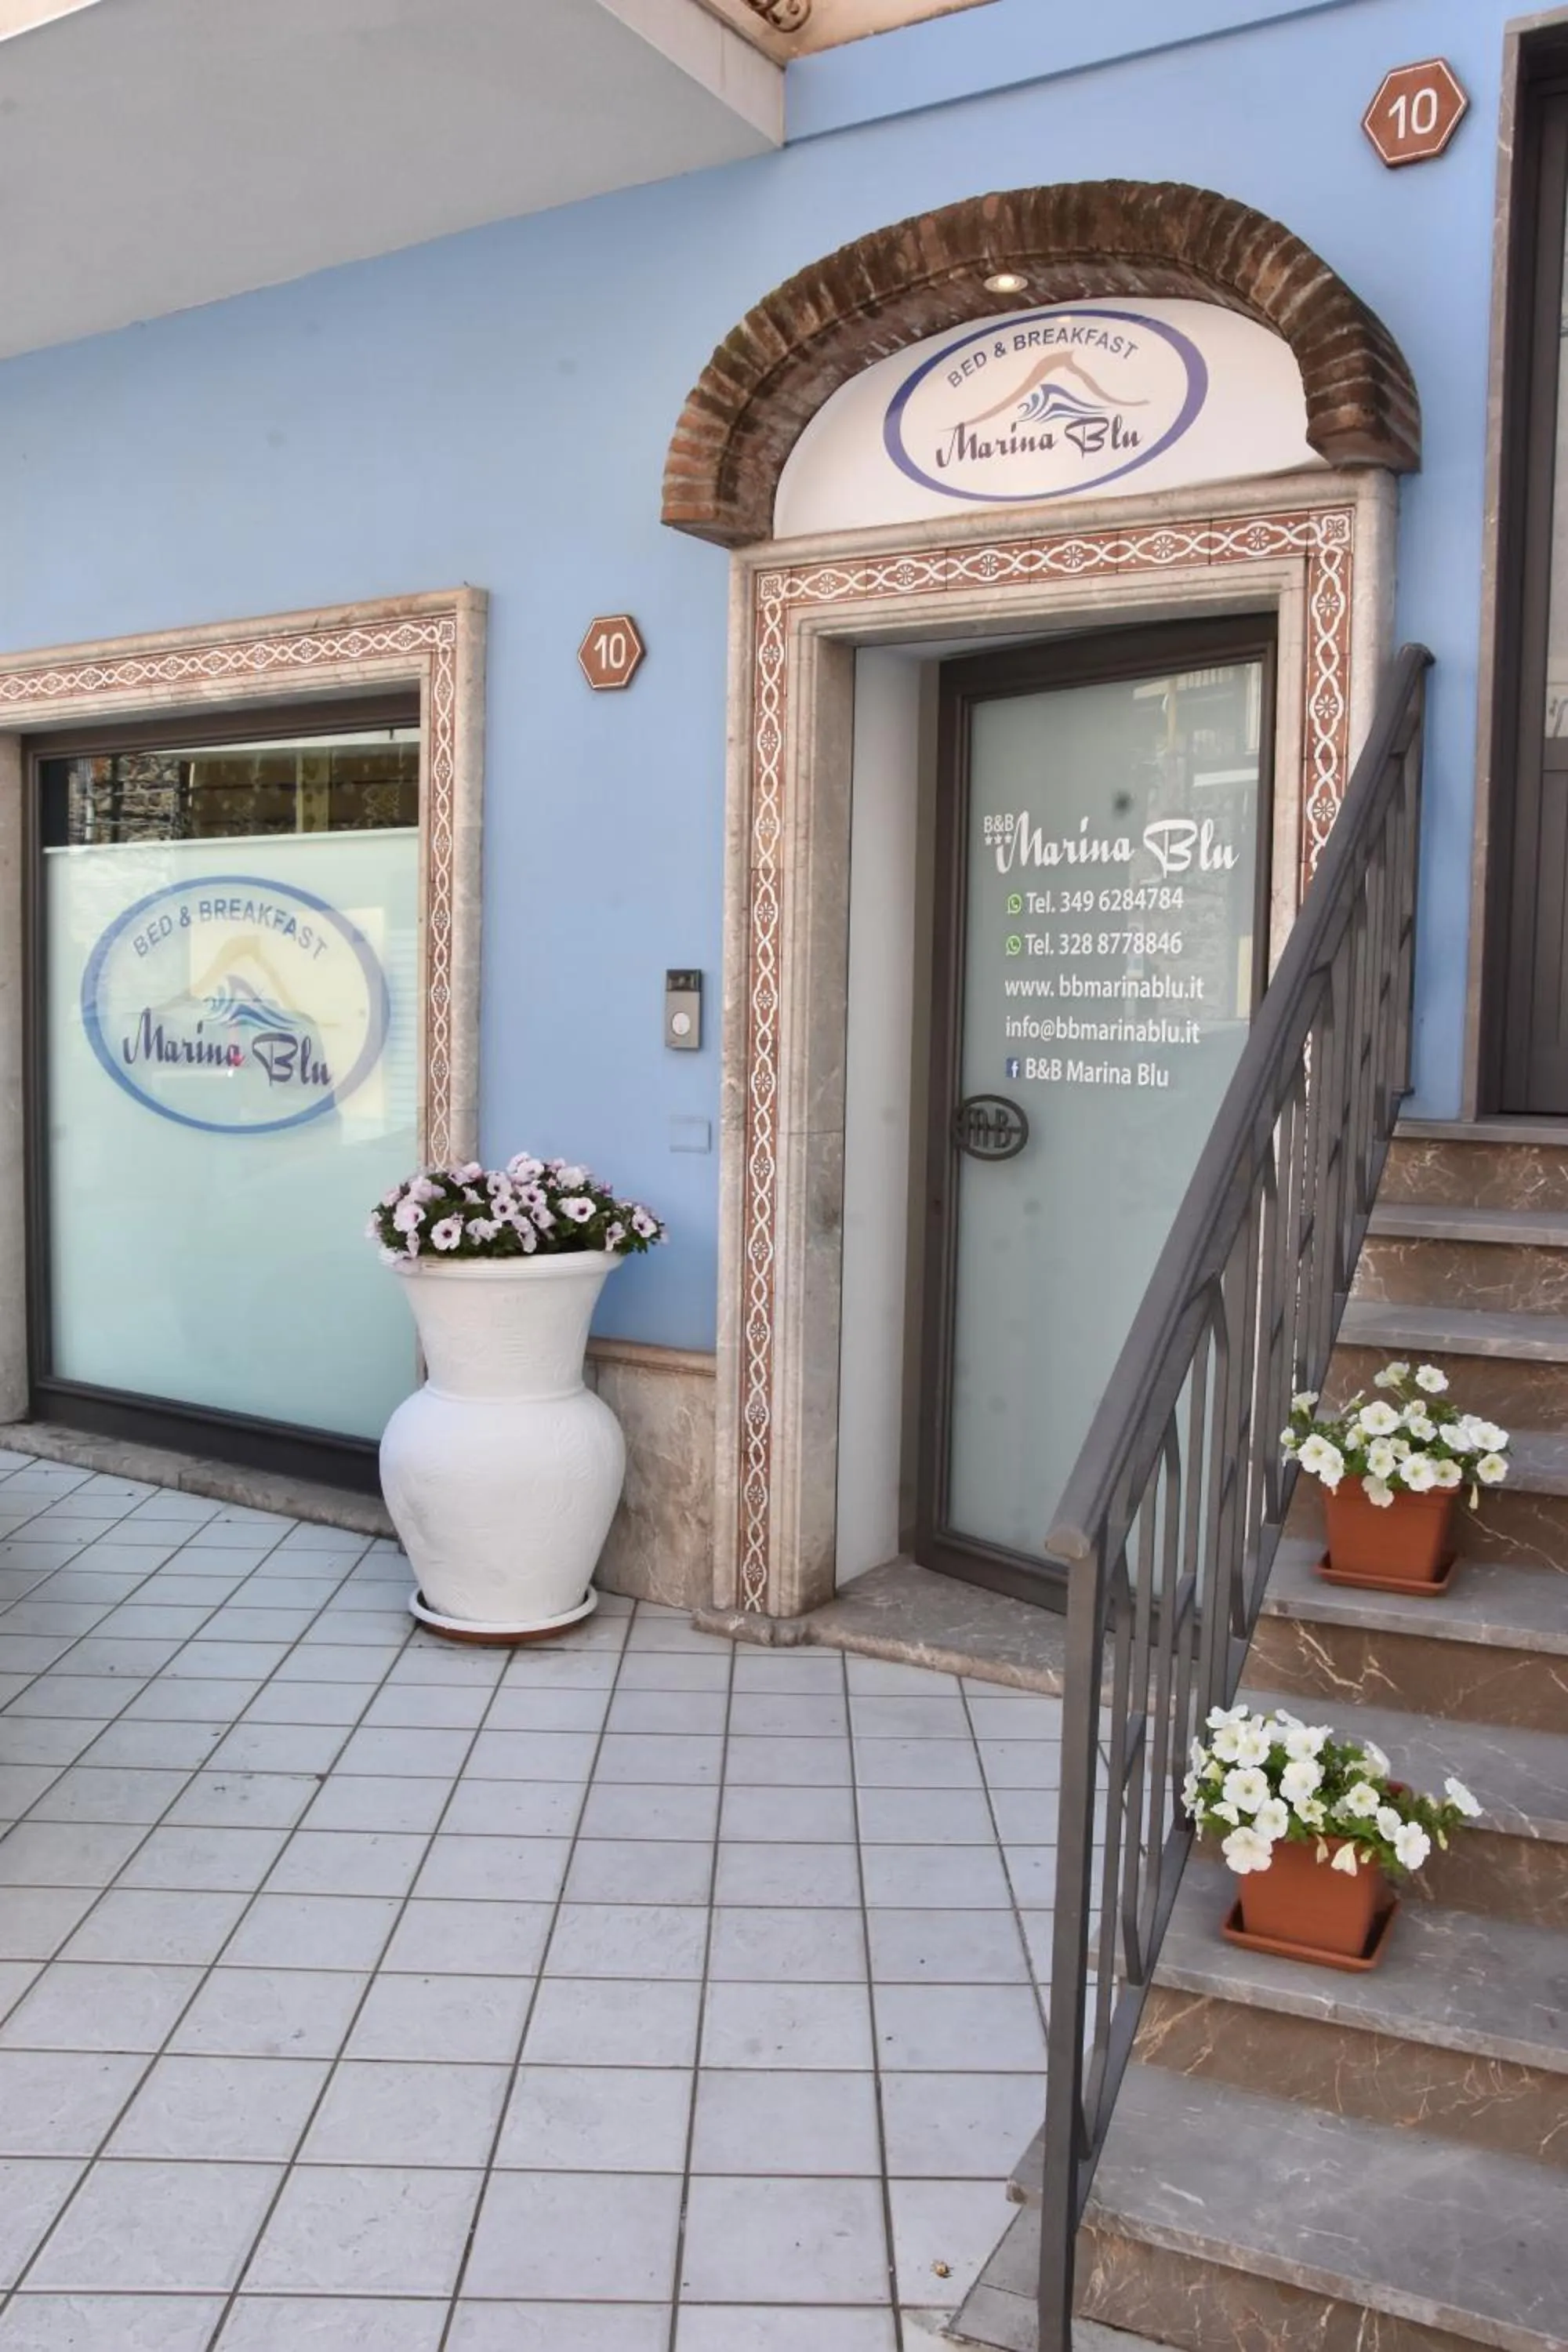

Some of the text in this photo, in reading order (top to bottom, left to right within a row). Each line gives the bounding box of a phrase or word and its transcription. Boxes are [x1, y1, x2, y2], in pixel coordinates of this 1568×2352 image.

[1388, 87, 1438, 139] 10
[946, 326, 1140, 388] BED & BREAKFAST
[935, 414, 1143, 469] Marina Blu
[593, 633, 626, 670] 10
[983, 813, 1014, 833] B&B
[996, 810, 1240, 879] Marina Blu
[1025, 887, 1184, 913] Tel. 349 6284784
[132, 898, 328, 960] BED & BREAKFAST
[1025, 932, 1183, 956] Tel. 328 8778846
[122, 1007, 332, 1087] Marina Blu
[1005, 1015, 1201, 1044] info@bbmarinablu.it
[1025, 1058, 1062, 1081] B&B
[1067, 1061, 1131, 1086] Marina
[1138, 1063, 1170, 1087] Blu
